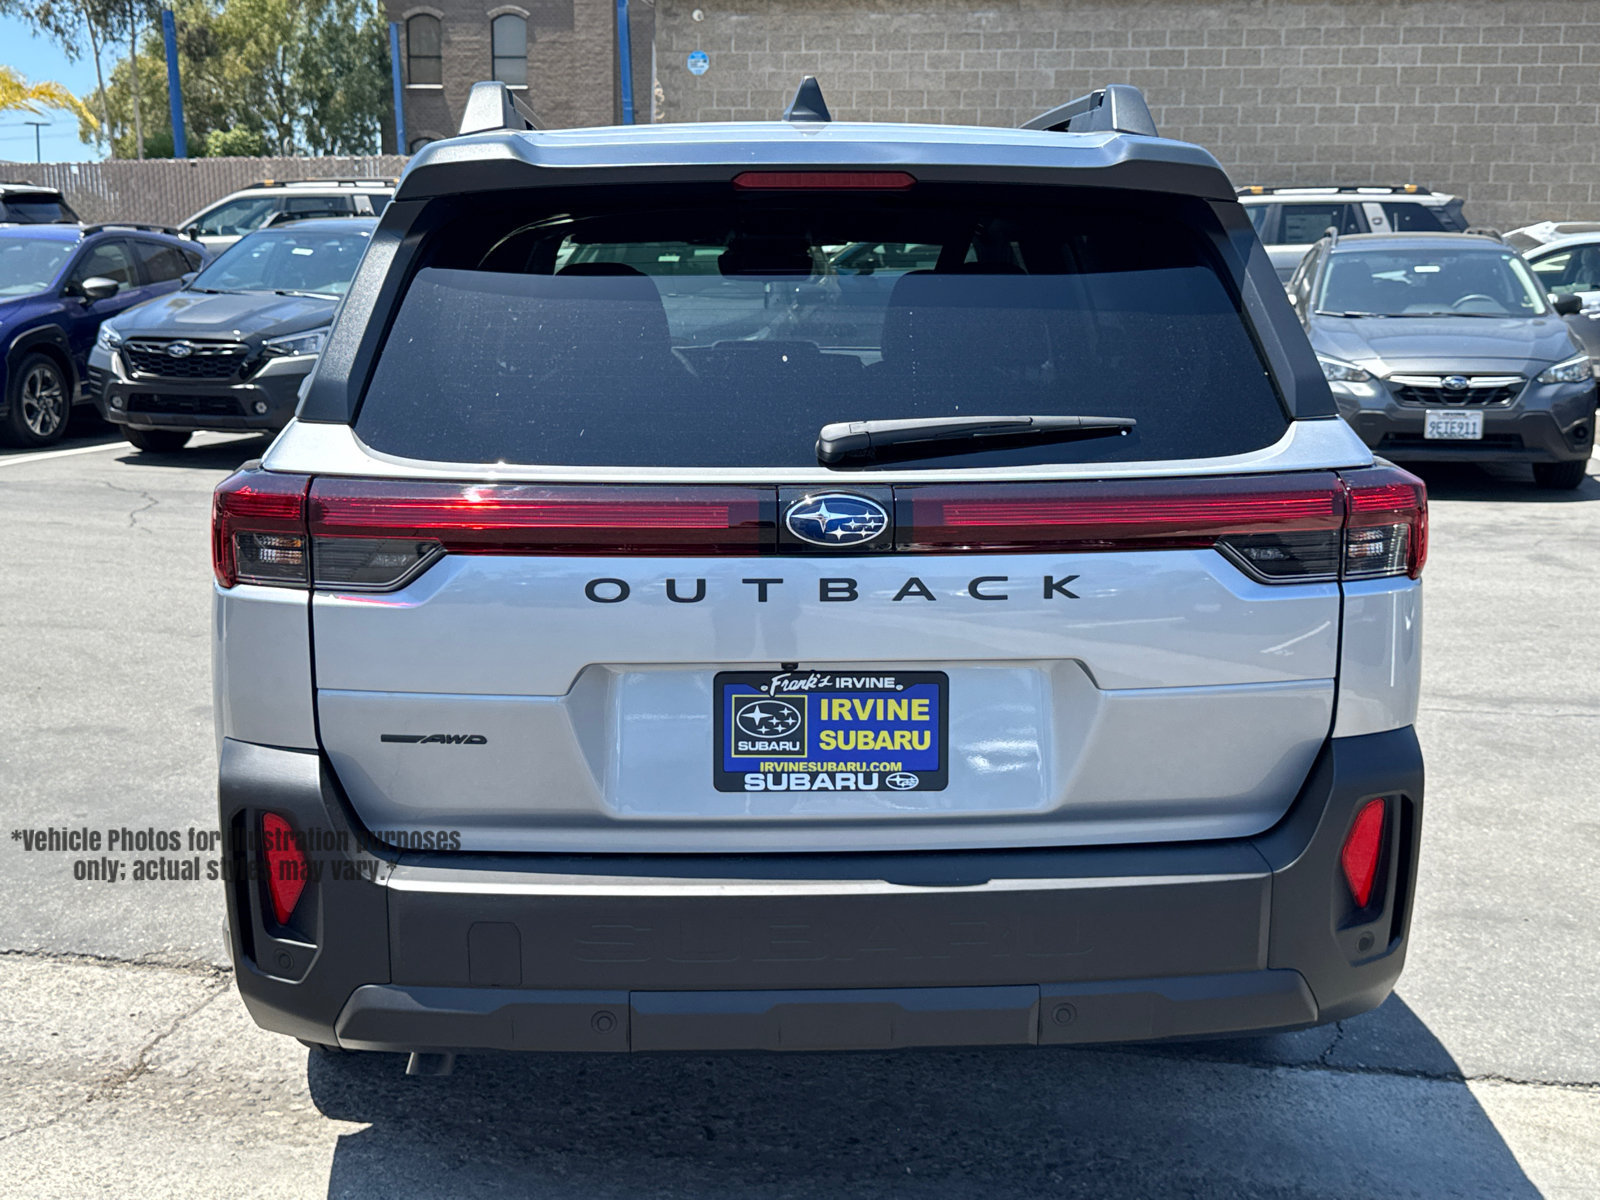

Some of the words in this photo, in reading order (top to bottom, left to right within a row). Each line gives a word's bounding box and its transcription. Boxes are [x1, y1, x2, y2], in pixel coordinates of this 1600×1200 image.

[584, 575, 1081, 603] OUTBACK
[770, 673, 832, 696] Frank's
[836, 677, 896, 689] IRVINE
[820, 698, 930, 721] IRVINE
[420, 733, 488, 745] AWD
[737, 741, 800, 751] SUBARU
[819, 730, 931, 750] SUBARU
[759, 761, 902, 772] IRVINESUBARU.COM
[743, 772, 879, 791] SUBARU
